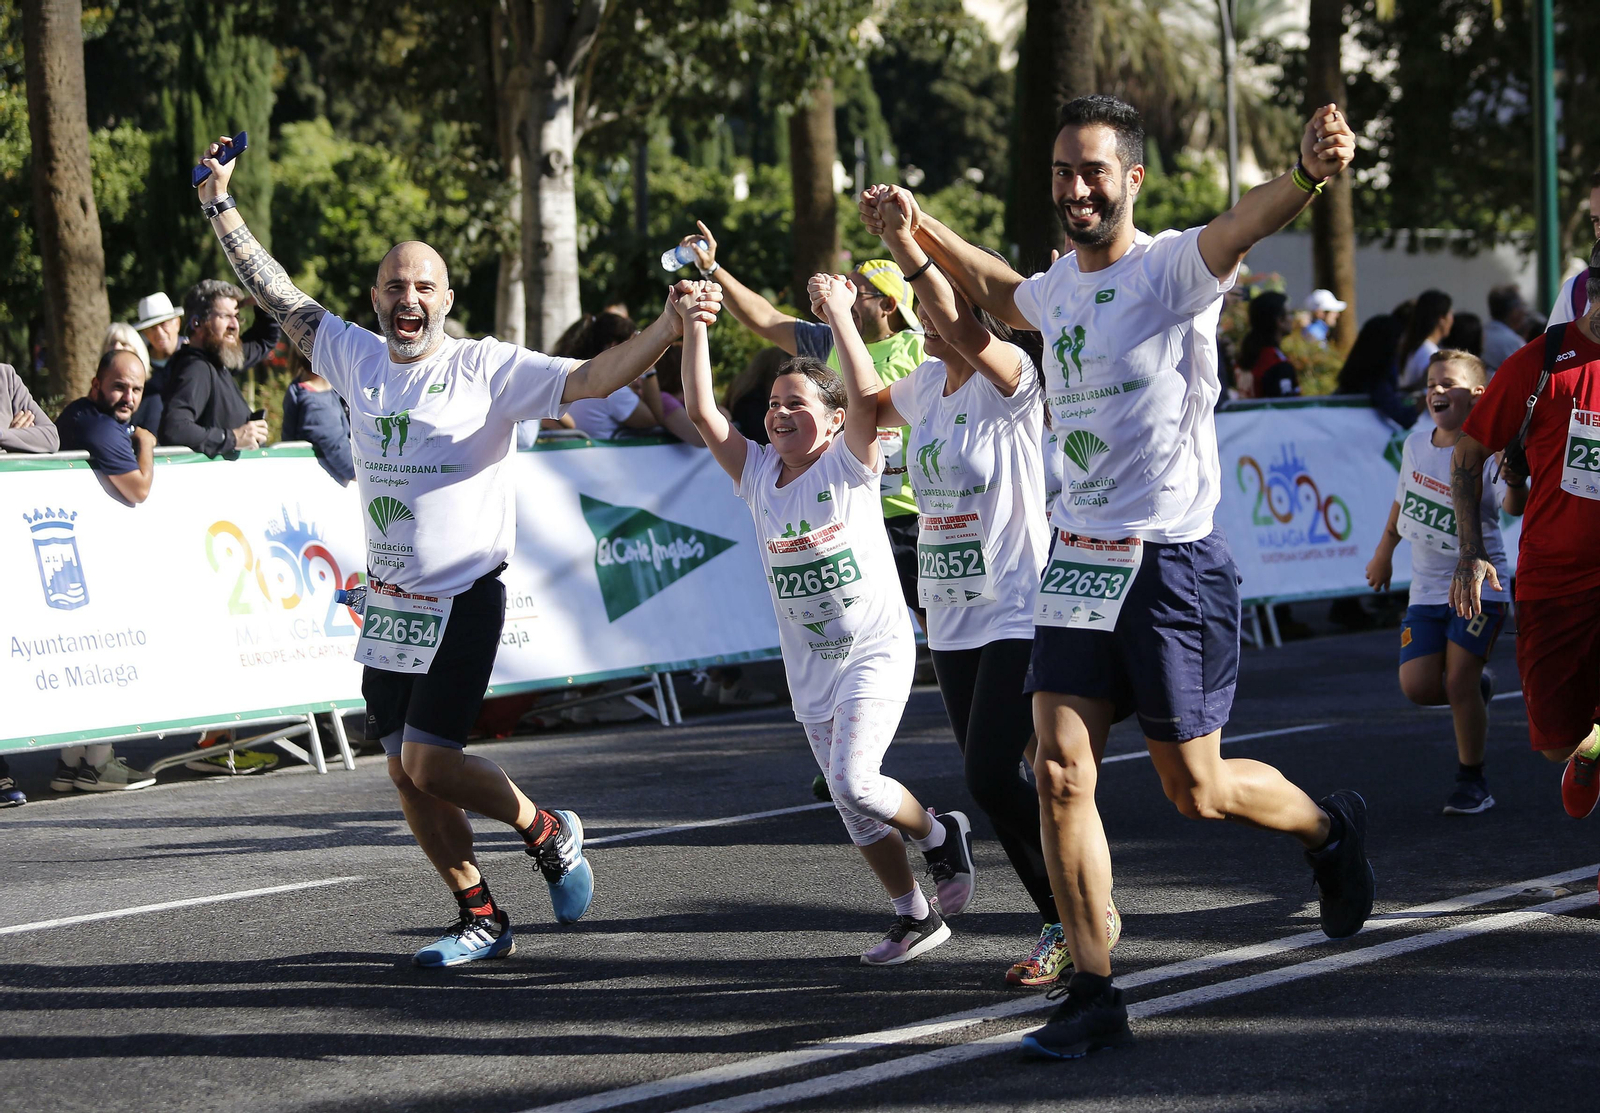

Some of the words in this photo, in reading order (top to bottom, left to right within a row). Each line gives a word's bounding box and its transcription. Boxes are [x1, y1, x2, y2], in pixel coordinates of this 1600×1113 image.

[1055, 392, 1085, 405] CARRERA
[1086, 386, 1120, 401] URBANA
[364, 461, 398, 473] CARRERA
[399, 465, 438, 474] URBANA
[1074, 493, 1109, 507] Unicaja
[1236, 455, 1352, 541] 2020
[944, 513, 979, 523] URBANA
[1404, 498, 1457, 533] 2314
[369, 539, 414, 553] Fundación
[597, 537, 614, 566] El
[612, 537, 652, 565] Corte
[648, 528, 705, 571] Inglés
[374, 556, 405, 570] Unicaja
[920, 549, 982, 578] 22652
[776, 556, 857, 598] 22655
[1044, 567, 1125, 598] 22653
[366, 613, 436, 646] 22654
[501, 623, 530, 649] caja
[809, 635, 855, 649] Fundación
[11, 627, 147, 662] Ayuntamiento
[820, 649, 850, 661] Unicaja
[35, 669, 60, 691] de
[64, 663, 139, 688] Málaga
